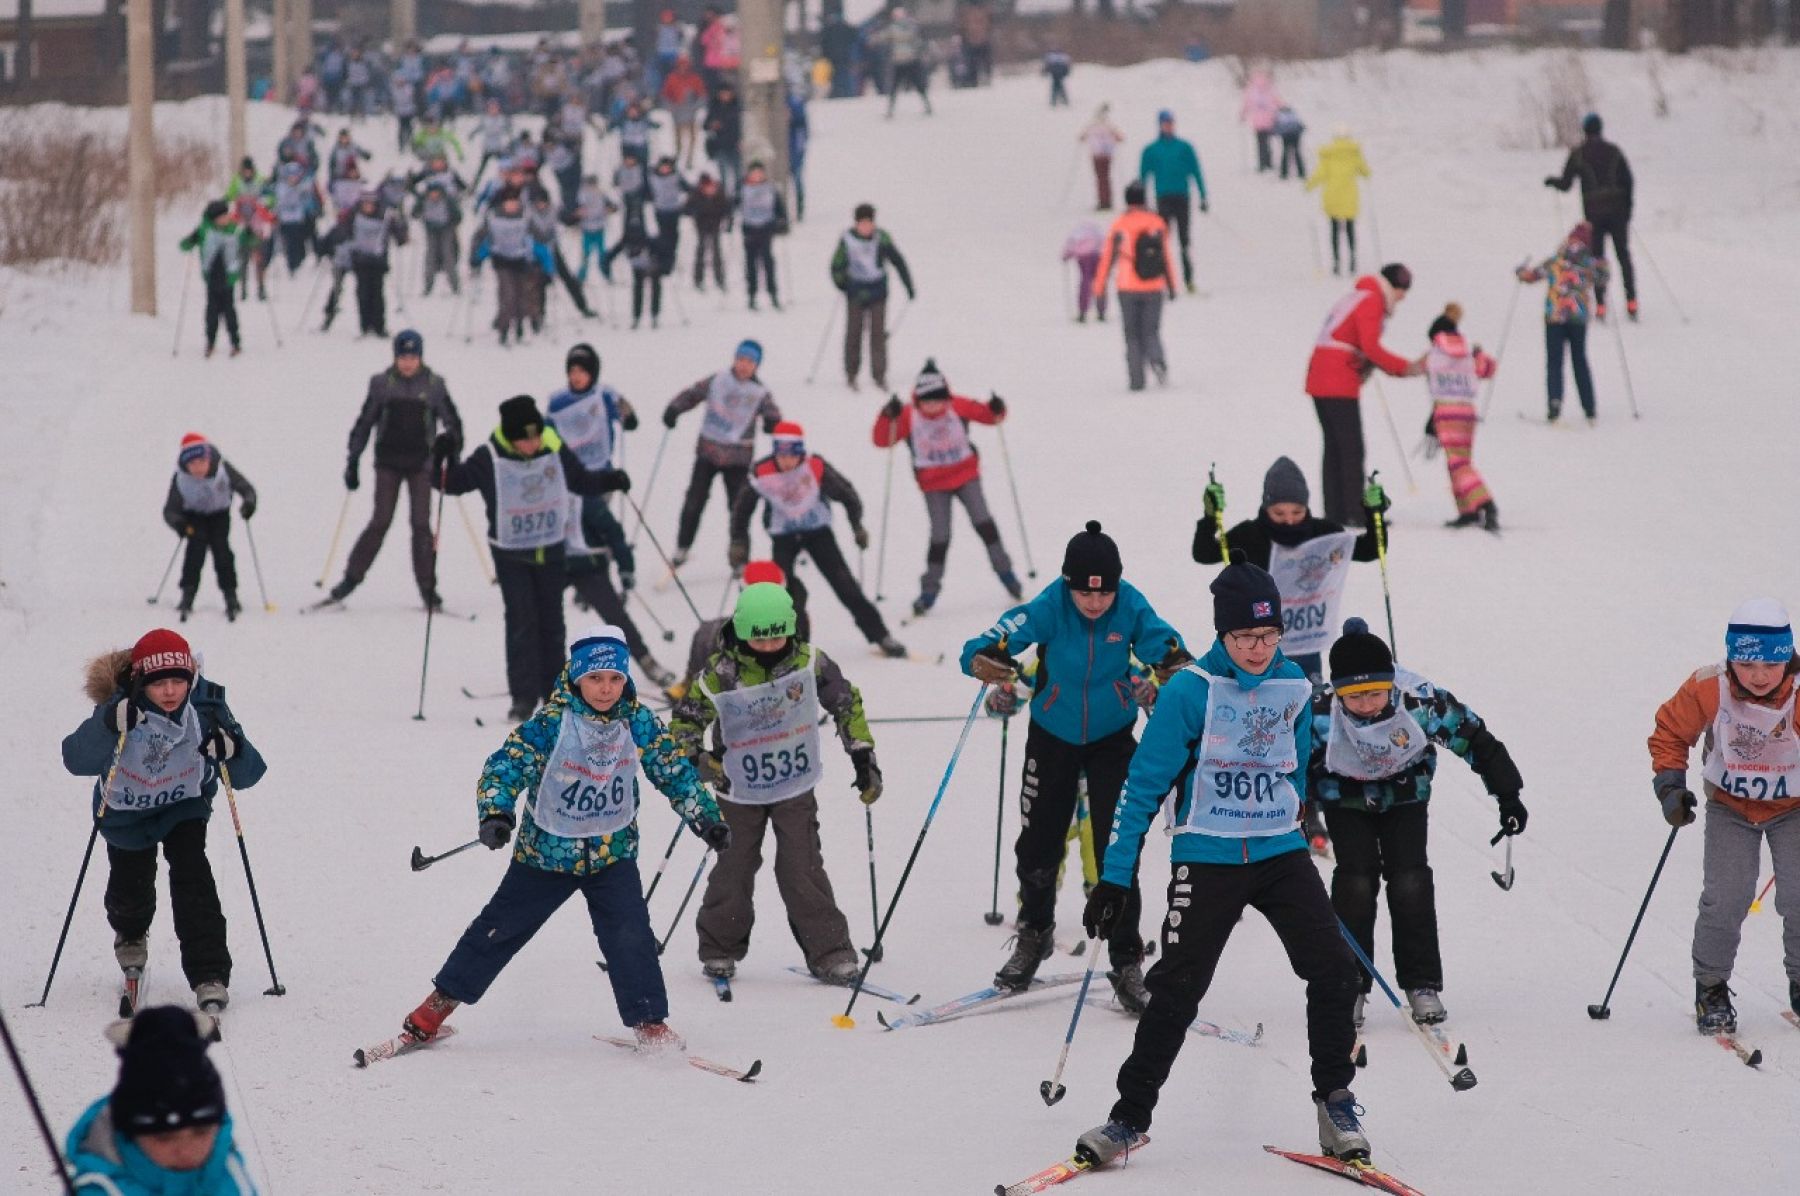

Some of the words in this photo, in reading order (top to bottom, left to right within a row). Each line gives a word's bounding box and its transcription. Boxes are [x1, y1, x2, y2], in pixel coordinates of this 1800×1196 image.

[511, 510, 557, 534] 9570
[742, 743, 809, 782] 9535
[1738, 763, 1770, 772] РОССИИ
[1720, 769, 1791, 801] 4524
[1209, 806, 1264, 819] Алтайский
[1266, 808, 1286, 819] край
